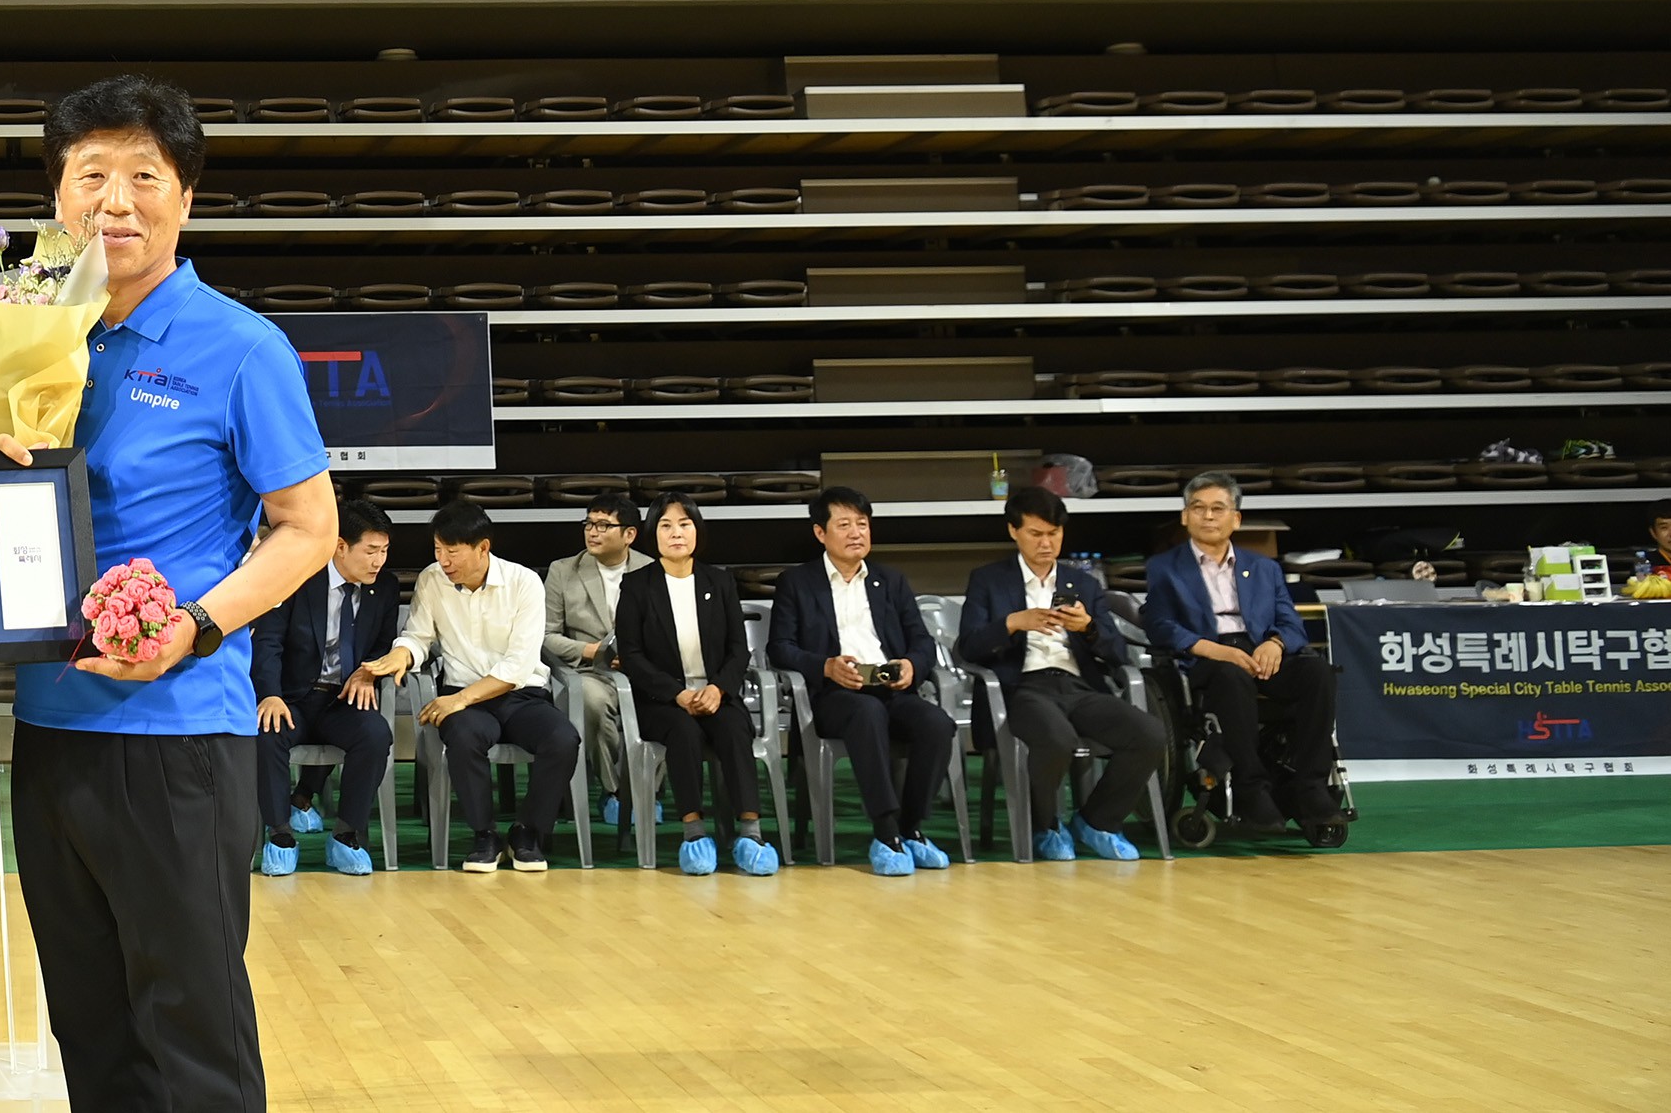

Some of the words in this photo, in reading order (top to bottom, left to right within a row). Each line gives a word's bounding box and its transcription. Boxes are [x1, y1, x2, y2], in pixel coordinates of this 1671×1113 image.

[131, 388, 179, 409] Umpire
[1383, 682, 1458, 699] Hwaseong
[1460, 682, 1511, 699] Special
[1514, 682, 1542, 698] City
[1546, 680, 1583, 694] Table
[1586, 679, 1632, 693] Tennis
[1467, 762, 1634, 775] 화성특례시탁구협회
